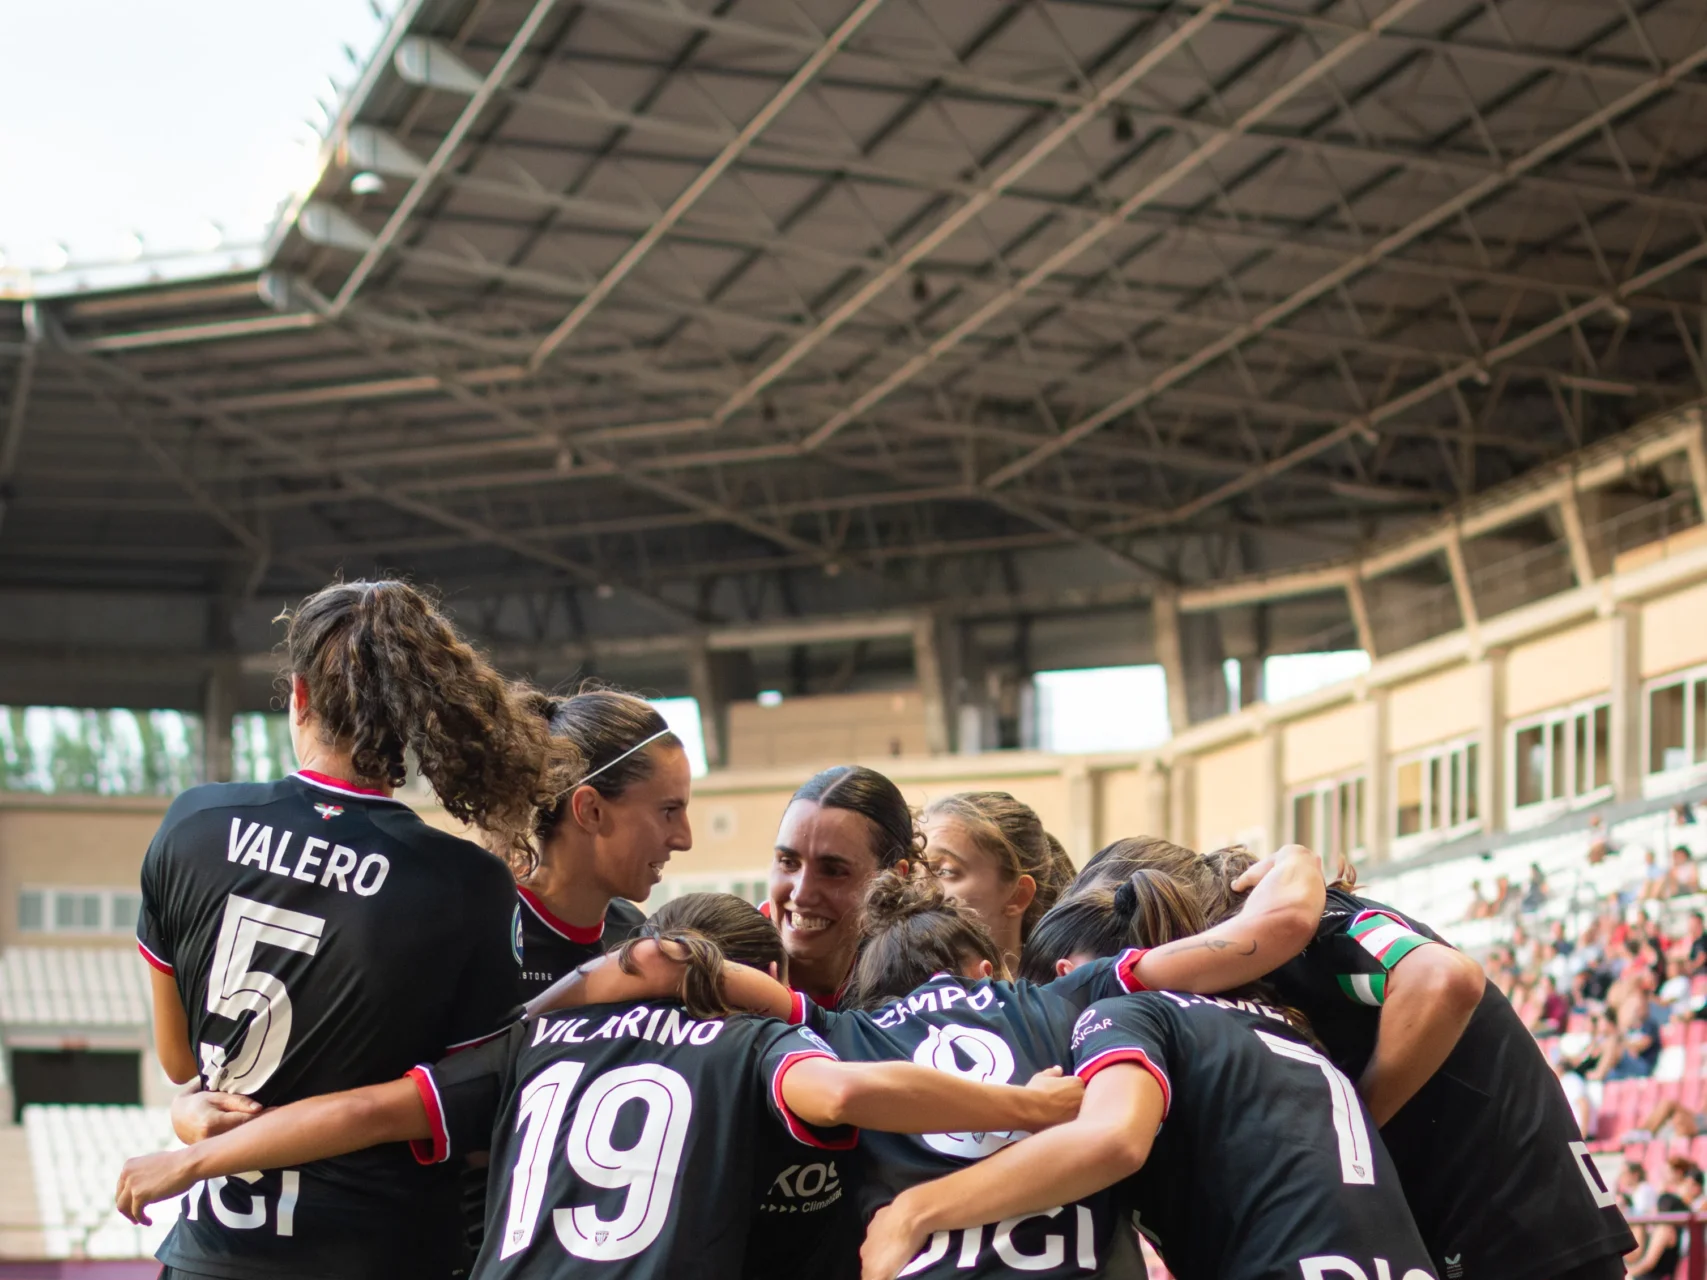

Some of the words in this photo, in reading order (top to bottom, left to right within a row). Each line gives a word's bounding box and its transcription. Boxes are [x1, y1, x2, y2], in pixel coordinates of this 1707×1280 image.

[227, 817, 390, 896] VALERO
[201, 894, 325, 1095] 5
[519, 972, 553, 981] STORE
[872, 986, 1005, 1029] CAMPO
[500, 1060, 693, 1260] 19
[1254, 1029, 1375, 1185] 7
